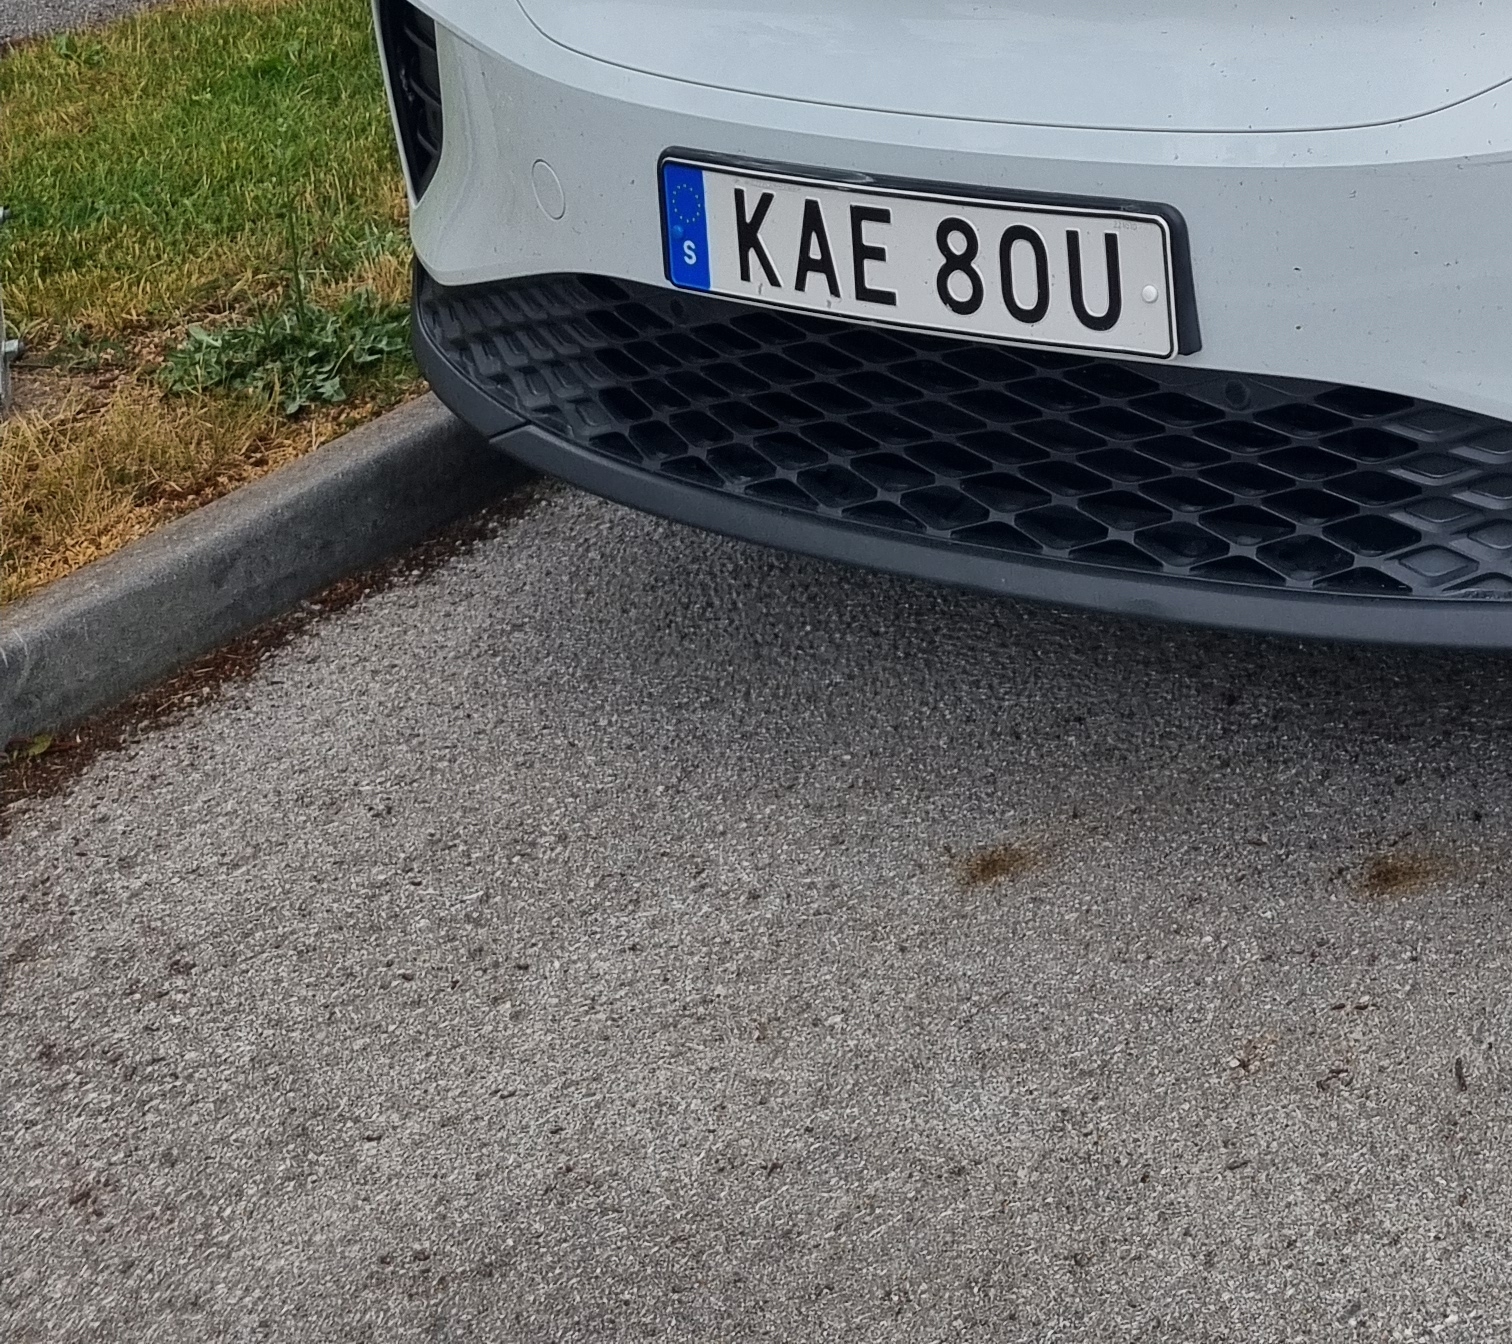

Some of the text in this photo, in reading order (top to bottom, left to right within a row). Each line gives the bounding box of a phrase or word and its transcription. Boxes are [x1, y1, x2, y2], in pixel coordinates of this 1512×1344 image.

[683, 187, 1121, 332] S KAE 80U
